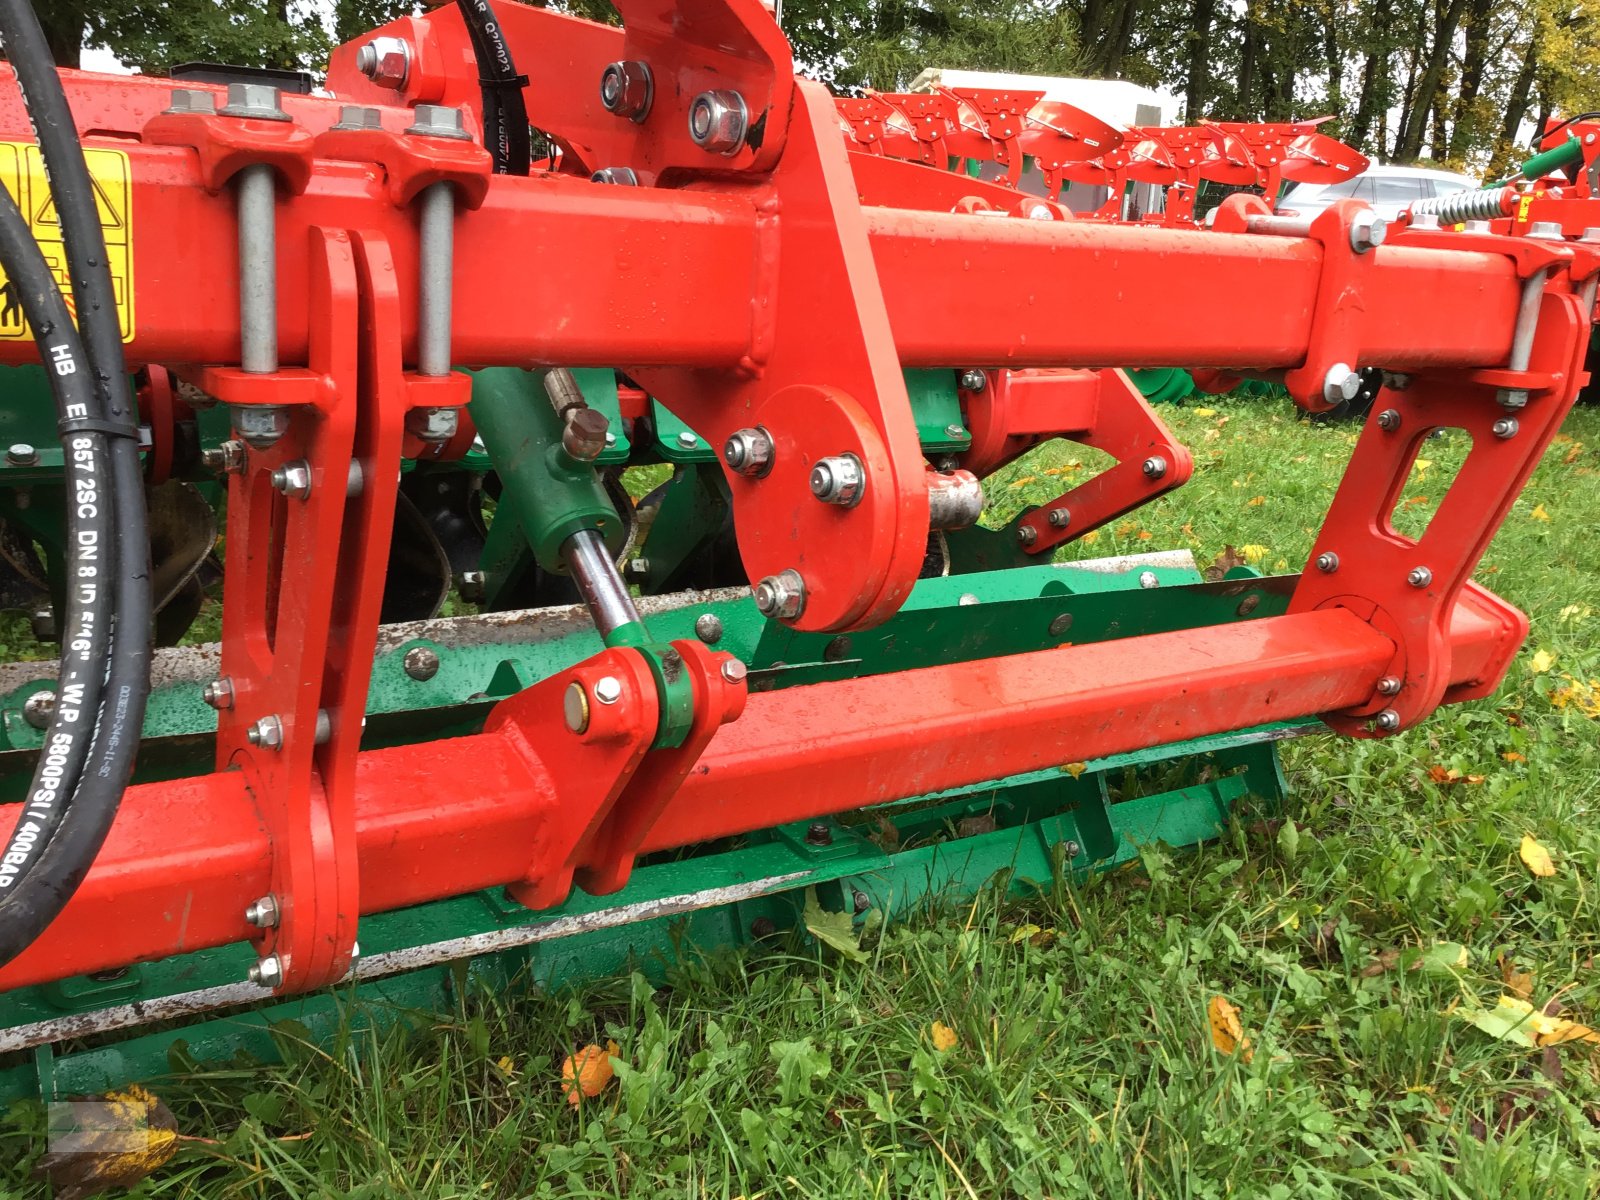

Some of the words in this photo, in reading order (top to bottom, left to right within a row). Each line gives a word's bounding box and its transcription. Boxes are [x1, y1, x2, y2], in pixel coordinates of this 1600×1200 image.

[50, 344, 76, 375] HB
[72, 438, 94, 472] 857
[76, 479, 97, 518] 2SC
[78, 531, 97, 560] DN
[78, 566, 97, 577] 8
[30, 732, 73, 808] 5800PSI
[26, 811, 47, 819] /
